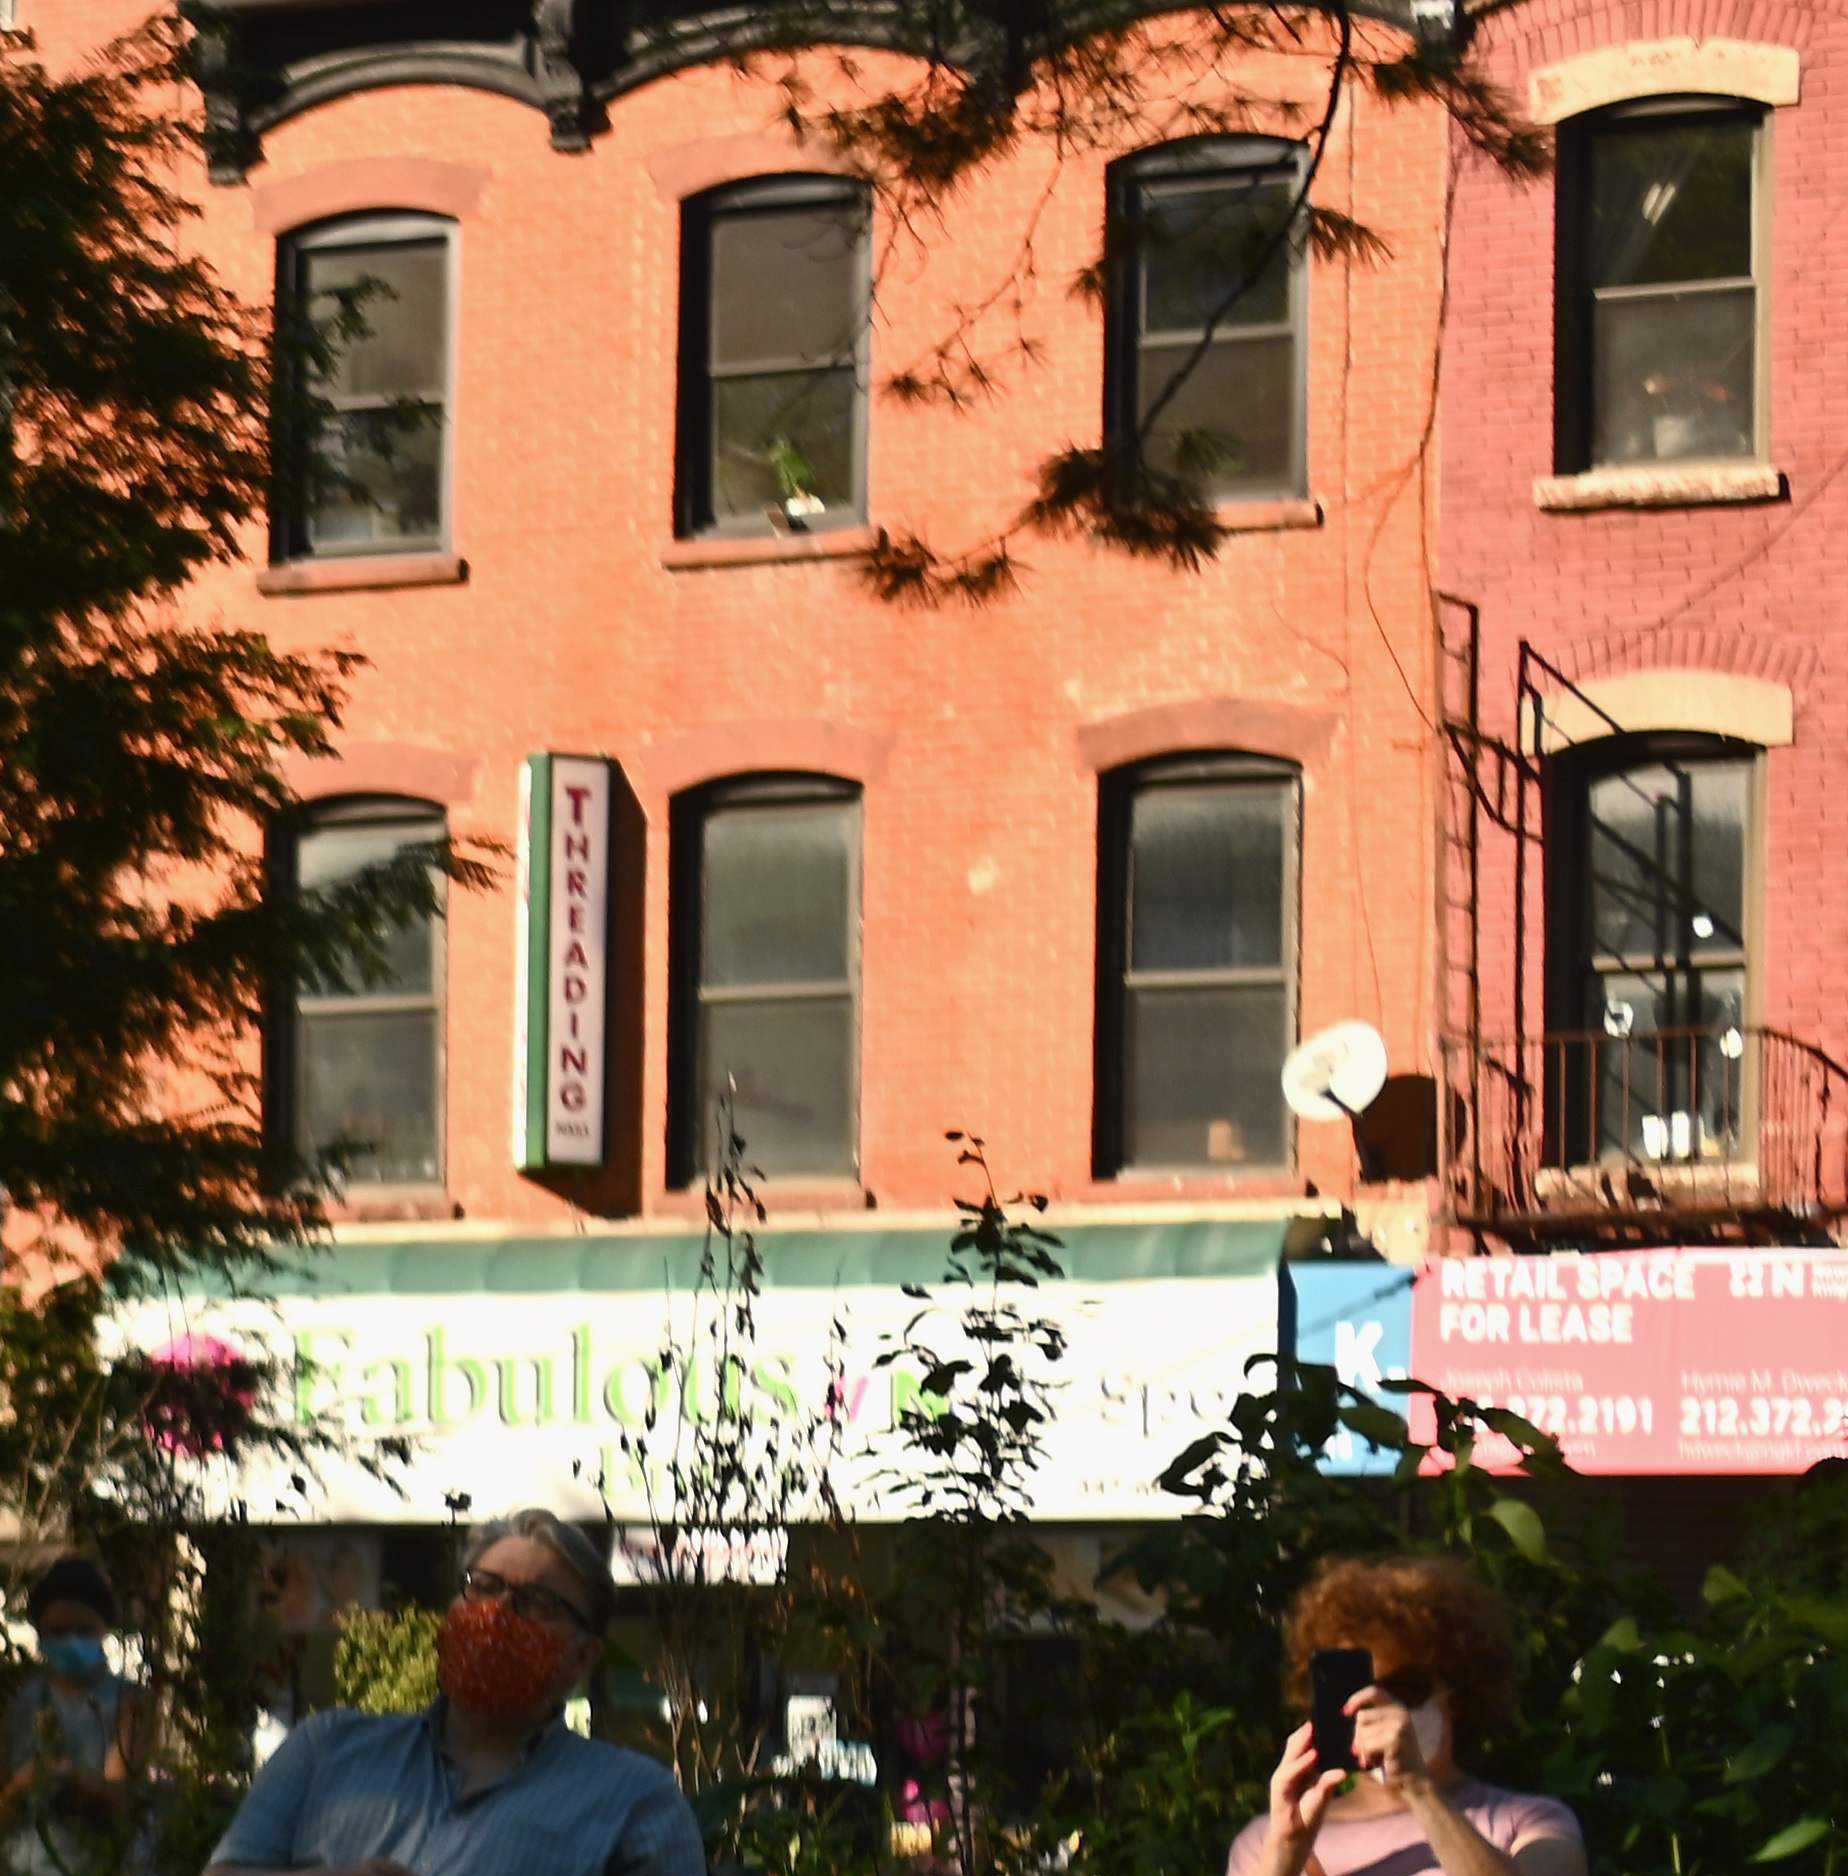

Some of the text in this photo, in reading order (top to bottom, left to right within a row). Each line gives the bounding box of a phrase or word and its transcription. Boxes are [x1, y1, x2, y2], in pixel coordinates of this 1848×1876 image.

[560, 786, 591, 1112] THREADING
[1441, 1257, 1695, 1299] RETAIL SPACE
[1440, 1303, 1633, 1343] FOR LEASE
[292, 1321, 799, 1427] Fabulous
